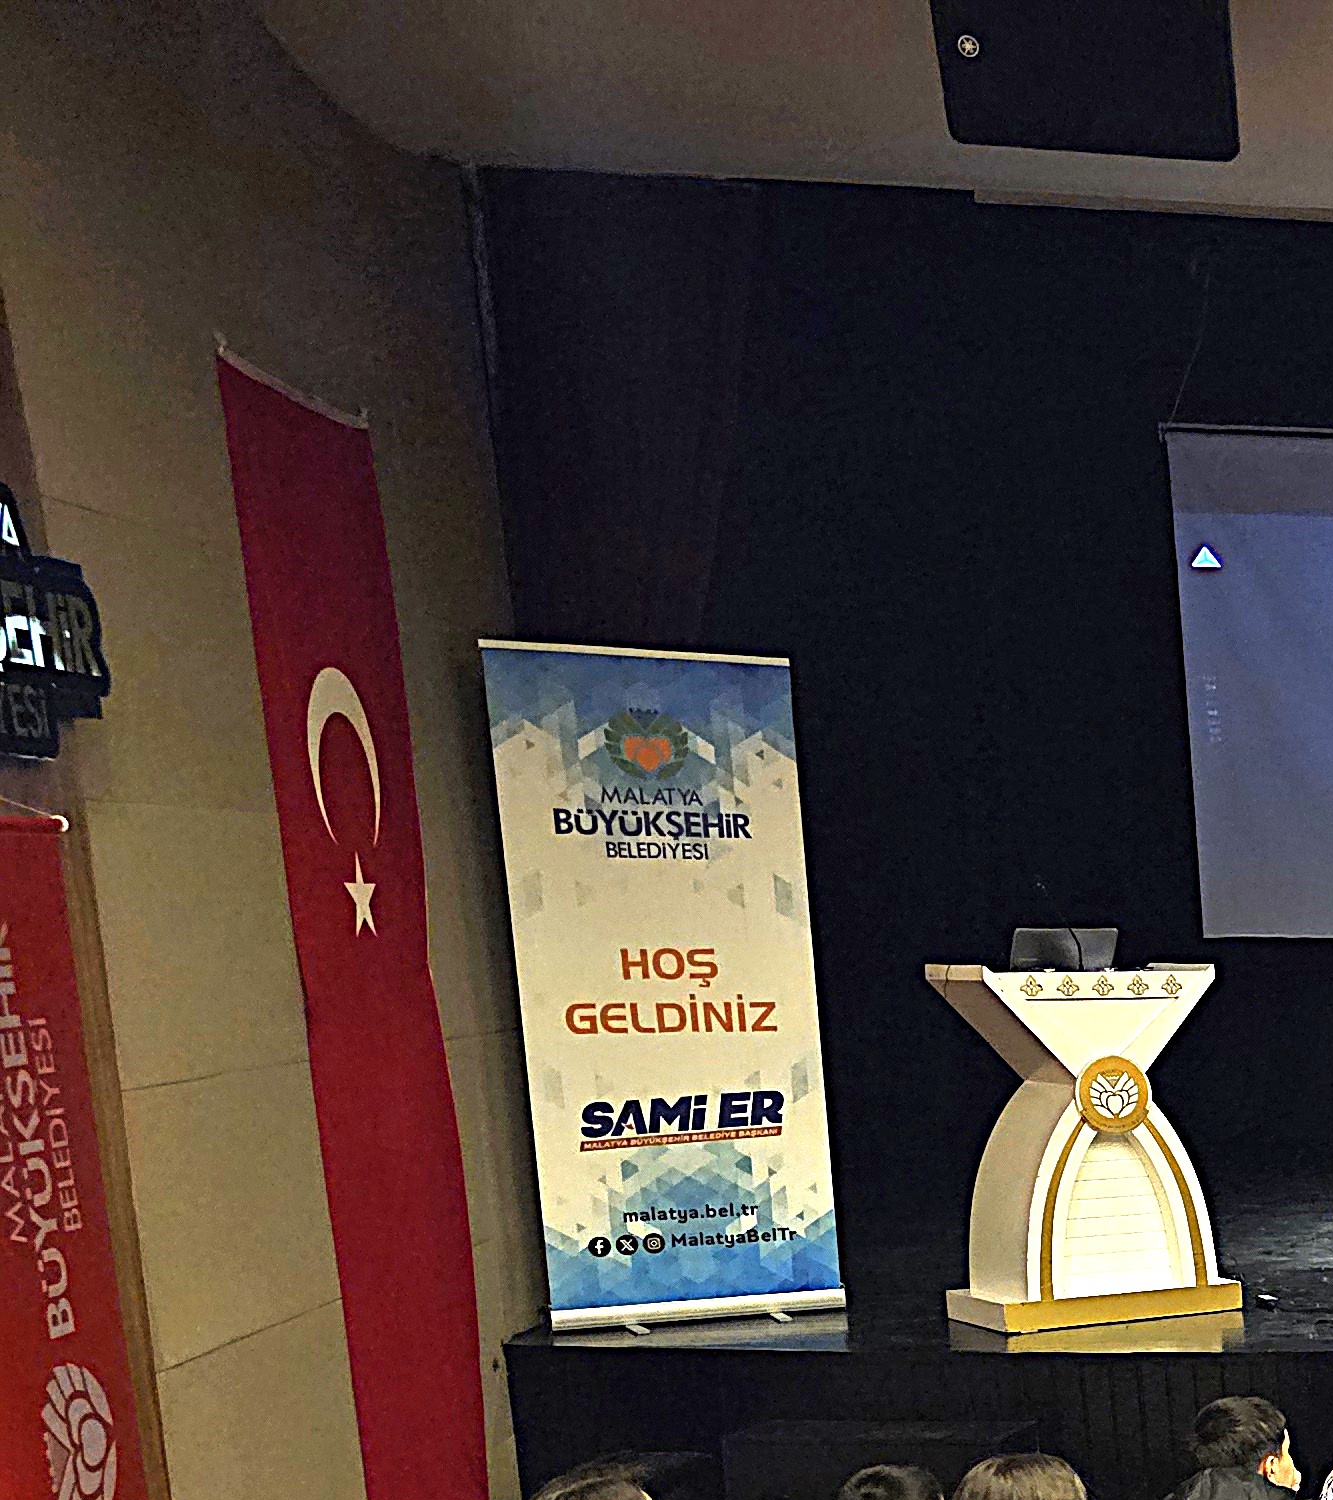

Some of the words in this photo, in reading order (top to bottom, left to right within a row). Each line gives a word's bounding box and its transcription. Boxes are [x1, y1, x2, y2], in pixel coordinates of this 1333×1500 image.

[601, 786, 703, 807] MALATYA
[553, 808, 752, 841] BÜYÜKŞEHİR
[620, 947, 719, 988] HOŞ
[565, 993, 778, 1035] GELDİNİZ
[718, 1090, 785, 1129] ER
[623, 1202, 759, 1224] malatya.bel.tr
[671, 1227, 798, 1249] MalatyaBelTr
